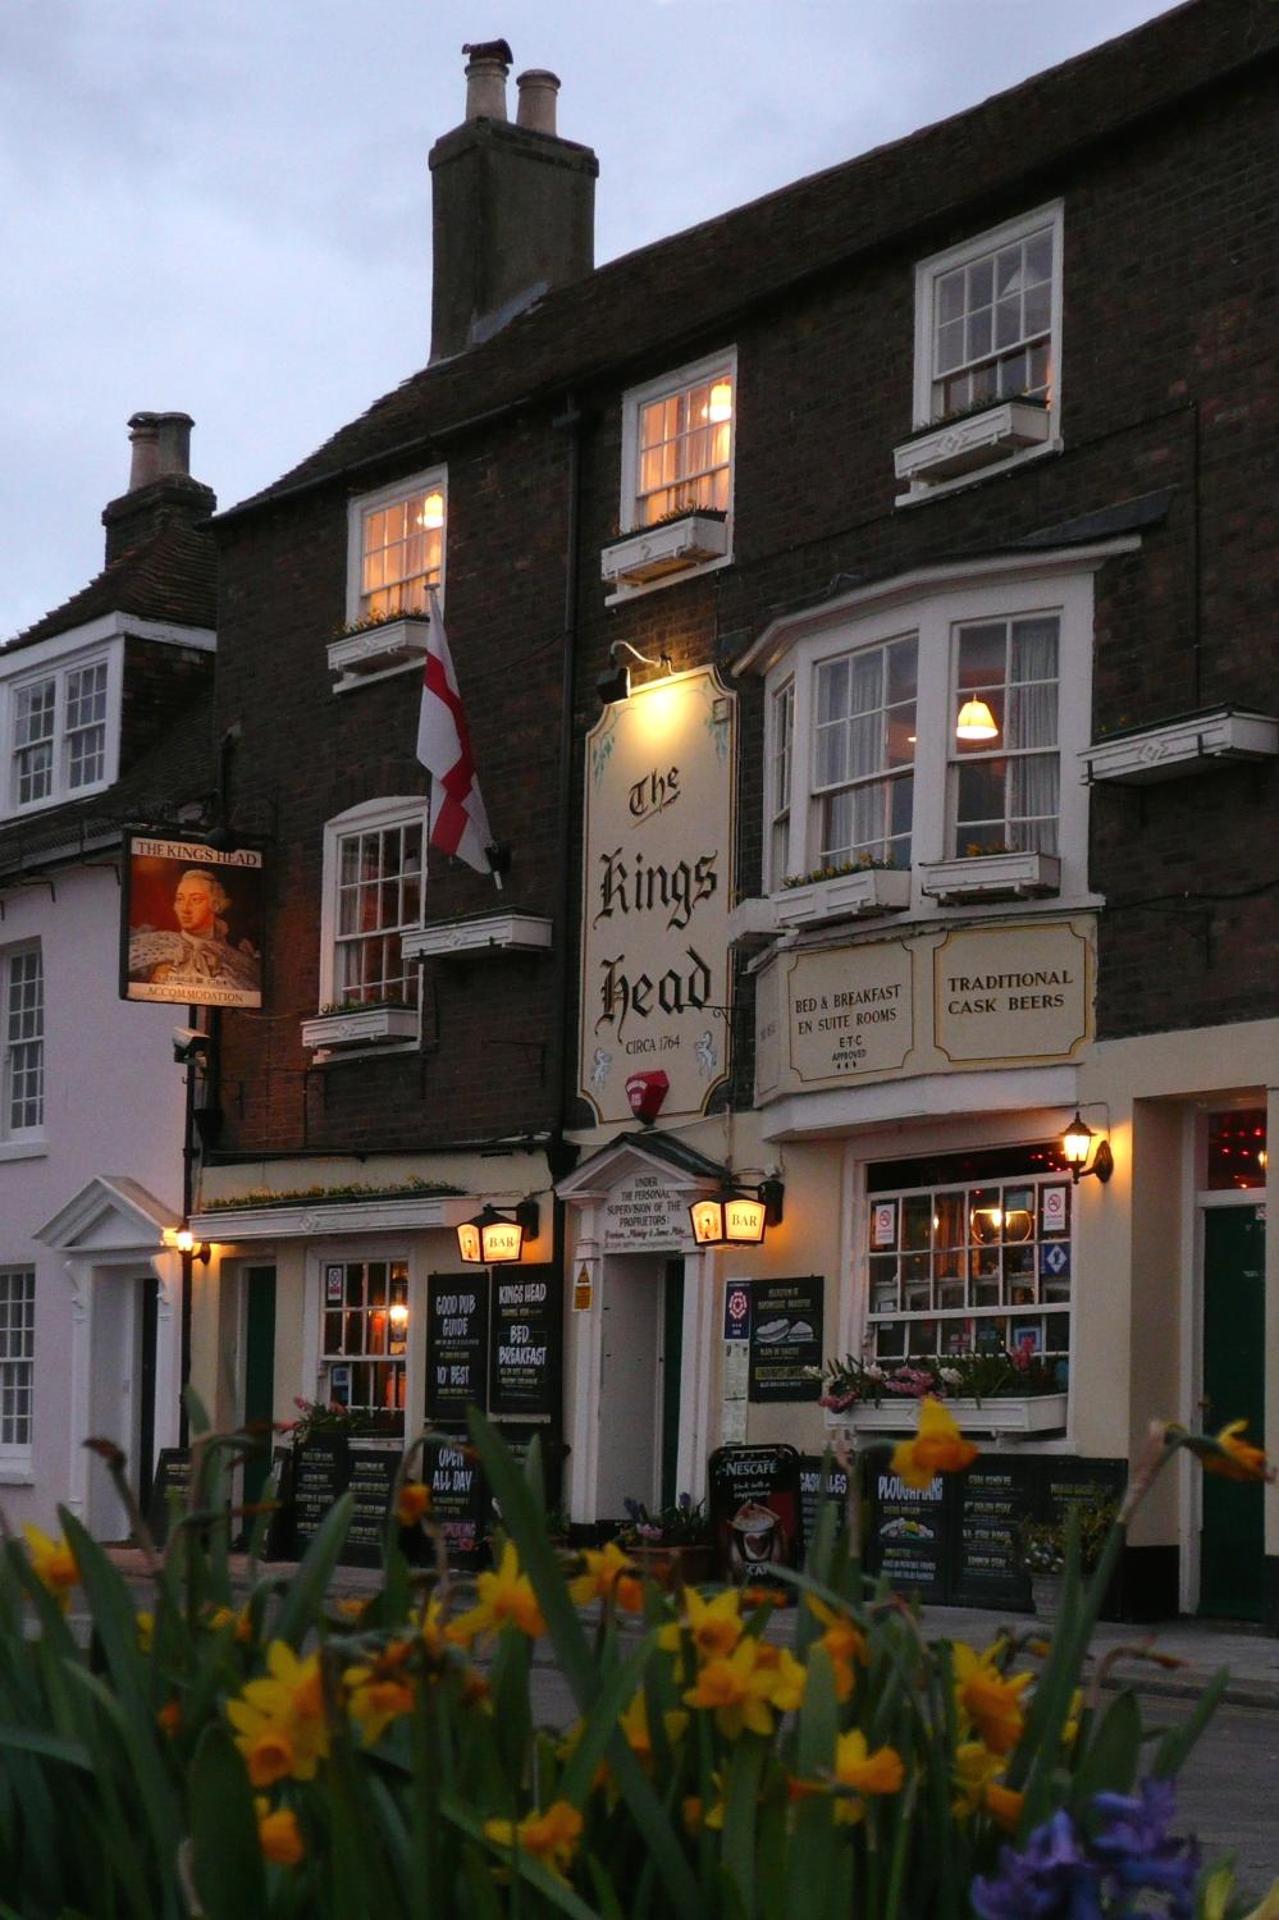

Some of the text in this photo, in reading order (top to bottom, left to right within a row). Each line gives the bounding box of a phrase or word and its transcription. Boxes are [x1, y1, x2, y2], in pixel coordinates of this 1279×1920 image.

[629, 764, 680, 819] The
[138, 841, 165, 855] THE
[217, 851, 257, 865] HEAD
[593, 847, 718, 931] Kings
[948, 970, 1073, 992] TRADITIONAL
[145, 986, 243, 1002] ACCOMMODATION
[594, 945, 712, 1042] Head
[795, 984, 902, 1014] BED & BREAKFAST
[948, 994, 1065, 1015] CASK BEERS
[798, 1008, 897, 1035] EN SUITE ROOMS
[626, 1035, 681, 1055] CIRCA 1764
[832, 1049, 867, 1062] APPROVED
[635, 1176, 658, 1187] UNDER
[622, 1189, 671, 1201] THE PERSONAL
[607, 1200, 682, 1215] SUPERVISION OF THE
[732, 1214, 757, 1227] BAR
[489, 1237, 514, 1248] BAR
[499, 1283, 546, 1305] KINGS HEAD
[436, 1294, 476, 1315] GOOD PUB
[442, 1317, 468, 1336] GUIDE
[510, 1325, 530, 1344] BED
[499, 1346, 547, 1366] BREAKFAST
[450, 1365, 470, 1385] BEST
[438, 1447, 464, 1467] OPEN
[432, 1470, 473, 1492] ALL DAY
[801, 1472, 822, 1492] CASK
